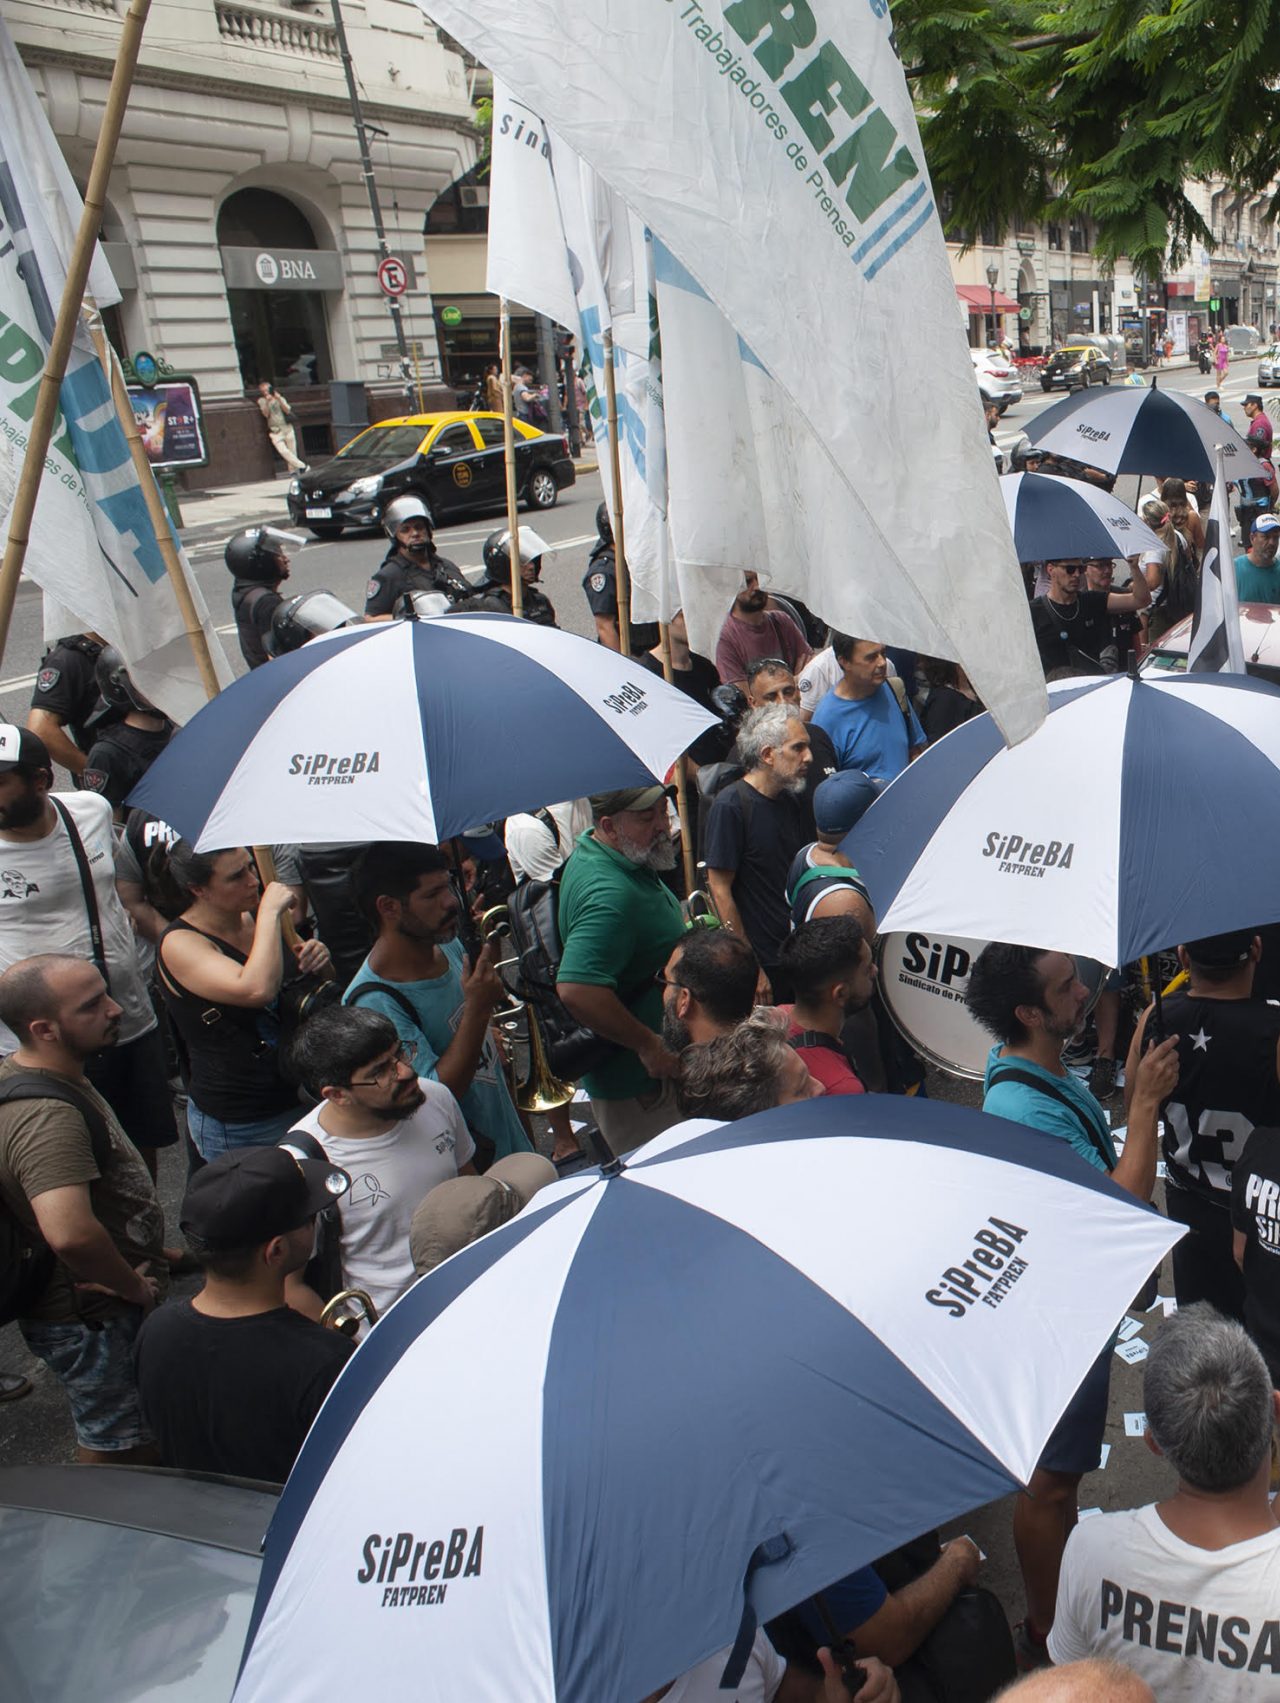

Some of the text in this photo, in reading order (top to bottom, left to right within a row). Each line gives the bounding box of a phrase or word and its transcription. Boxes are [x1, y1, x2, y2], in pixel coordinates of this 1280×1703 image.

[680, 0, 857, 248] Trabajadores de Prensa
[280, 259, 317, 280] BNA
[1076, 423, 1111, 442] SiPreBA
[602, 681, 648, 714] SiPreBA
[288, 751, 379, 776] SiPreBA
[307, 775, 356, 785] FATPREN
[982, 831, 1075, 870] SiPreBA
[998, 861, 1046, 878] FATPREN
[898, 973, 941, 995] Sindicato
[942, 988, 953, 1000] de
[925, 1216, 1029, 1318] SiPreBA
[982, 1256, 1029, 1309] FATPREN
[357, 1525, 484, 1584] SiPreBA
[381, 1584, 448, 1607] FATPREN
